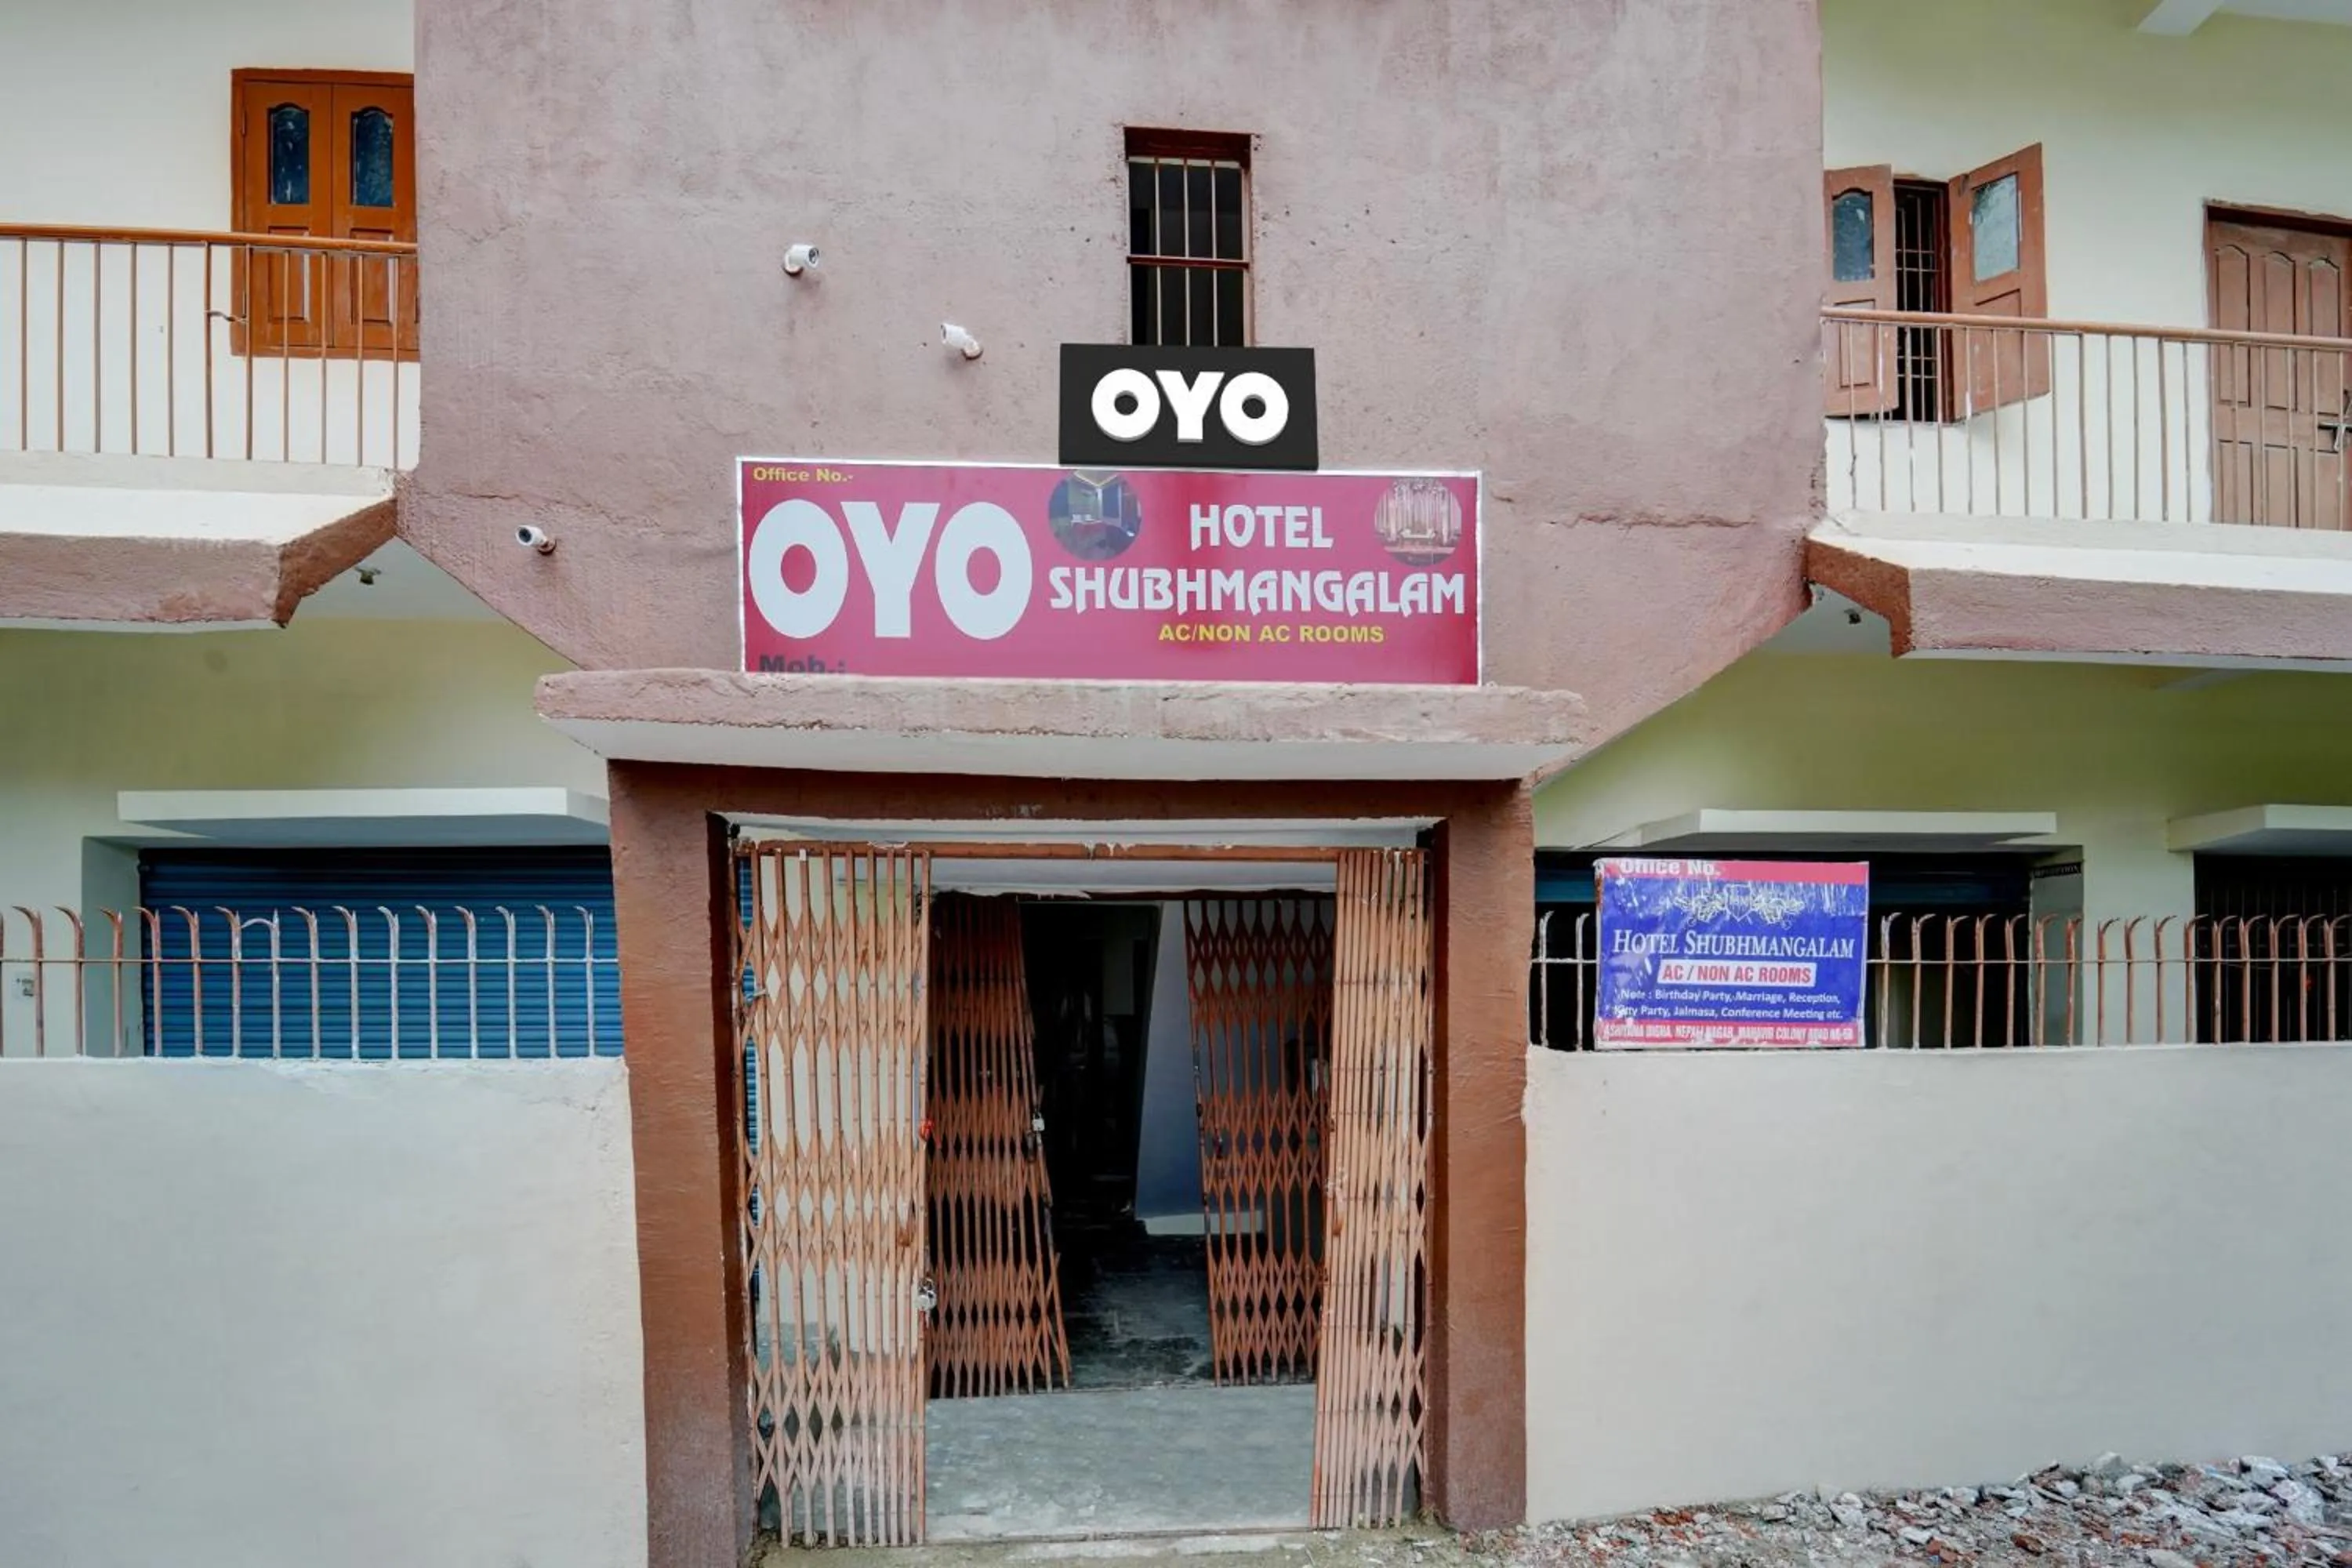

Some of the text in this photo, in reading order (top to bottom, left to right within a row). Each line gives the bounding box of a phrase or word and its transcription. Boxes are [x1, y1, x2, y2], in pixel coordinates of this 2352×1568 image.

[1091, 367, 1290, 445] OYO
[753, 466, 810, 481] Office
[1190, 504, 1334, 551] HOTEL
[749, 497, 1033, 641] OYO
[1049, 567, 1465, 617] SHUBHMANGALAM
[1158, 624, 1385, 644] AC/NON AC ROOMS
[1612, 929, 1856, 959] HOTEL SHUBHMANGALAM
[1662, 965, 1684, 981] AC
[1697, 965, 1726, 982] NON
[1733, 967, 1755, 982] AC
[1758, 967, 1812, 984] ROOMS
[1655, 988, 1701, 1002] Birthday
[1702, 990, 1733, 1003] Party,
[1735, 991, 1786, 1004] Marriage,
[1788, 992, 1840, 1004] Reception,
[1641, 1005, 1671, 1018] Party,
[1721, 1007, 1780, 1018] Conference
[1783, 1008, 1825, 1020] Meeting
[1827, 1010, 1843, 1019] etc.
